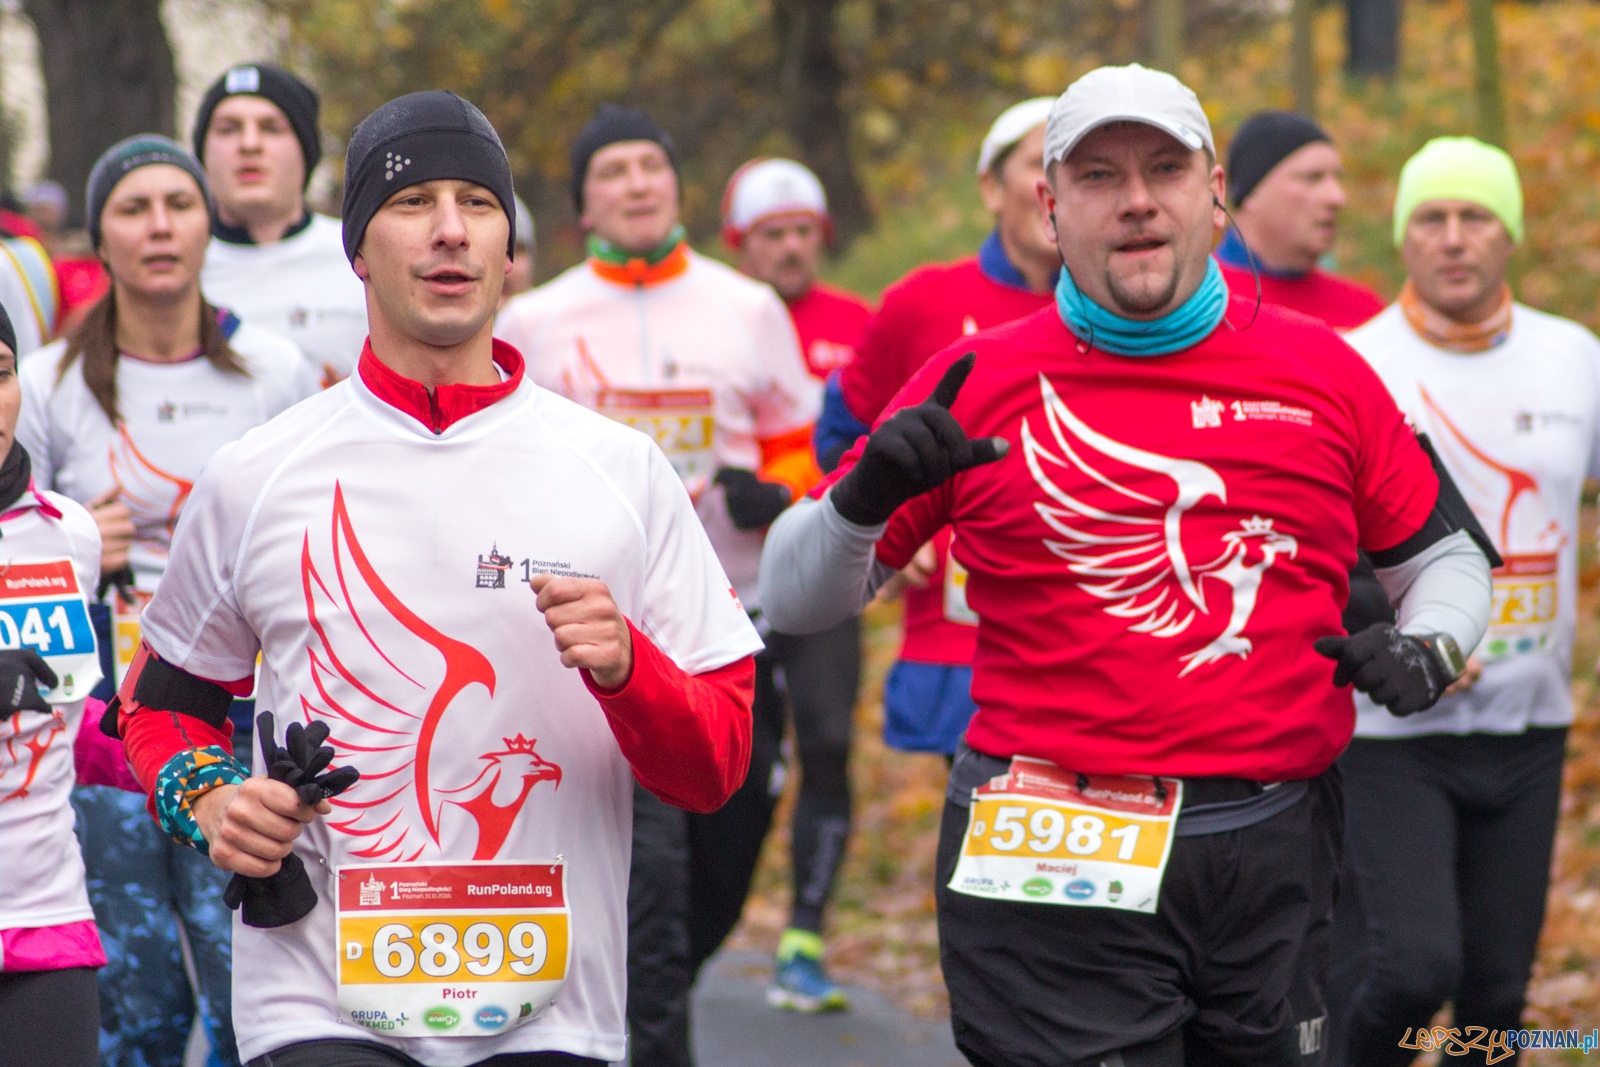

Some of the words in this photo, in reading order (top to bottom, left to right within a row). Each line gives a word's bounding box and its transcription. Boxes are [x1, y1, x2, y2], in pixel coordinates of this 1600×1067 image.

[1230, 400, 1247, 421] 1
[519, 558, 531, 583] 1
[532, 560, 571, 570] Poznański
[5, 575, 68, 590] RunPoland.org
[972, 821, 986, 837] D
[989, 806, 1142, 862] 5981
[1036, 862, 1078, 876] Maciej
[389, 881, 401, 900] 1
[468, 884, 553, 897] RunPoland.org
[345, 941, 363, 960] D
[372, 922, 548, 978] 6899
[442, 988, 478, 999] Piotr
[351, 1010, 388, 1020] GRUPA
